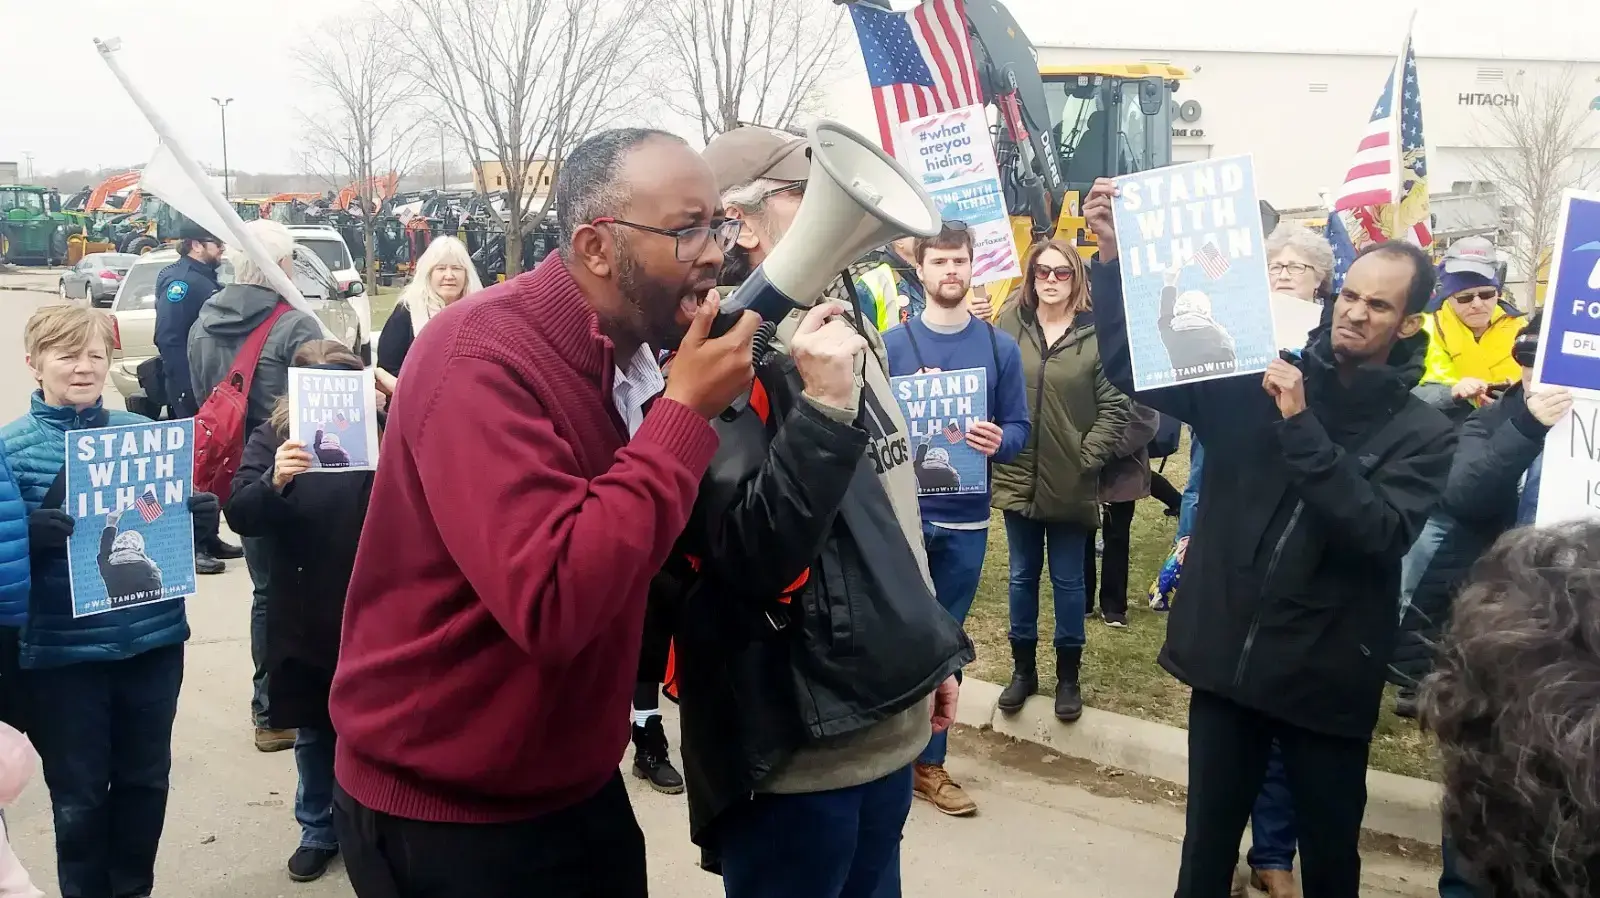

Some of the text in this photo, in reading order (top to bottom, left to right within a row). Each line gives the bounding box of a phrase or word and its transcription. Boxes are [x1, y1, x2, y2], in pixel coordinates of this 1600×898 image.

[1458, 92, 1520, 107] HITACHI
[919, 122, 966, 142] #what
[920, 136, 971, 155] areyou
[925, 153, 972, 171] hiding
[1040, 130, 1061, 188] DEERE
[961, 184, 992, 199] WITH
[1123, 163, 1243, 211] STAND
[1136, 197, 1236, 240] WITH
[1573, 339, 1596, 351] DFL
[302, 376, 359, 392] STAND
[899, 374, 979, 400] STAND
[307, 393, 354, 407] WITH
[907, 396, 972, 418] WITH
[911, 416, 980, 437] LHN
[77, 426, 185, 461] STAND
[88, 454, 174, 488] WITH
